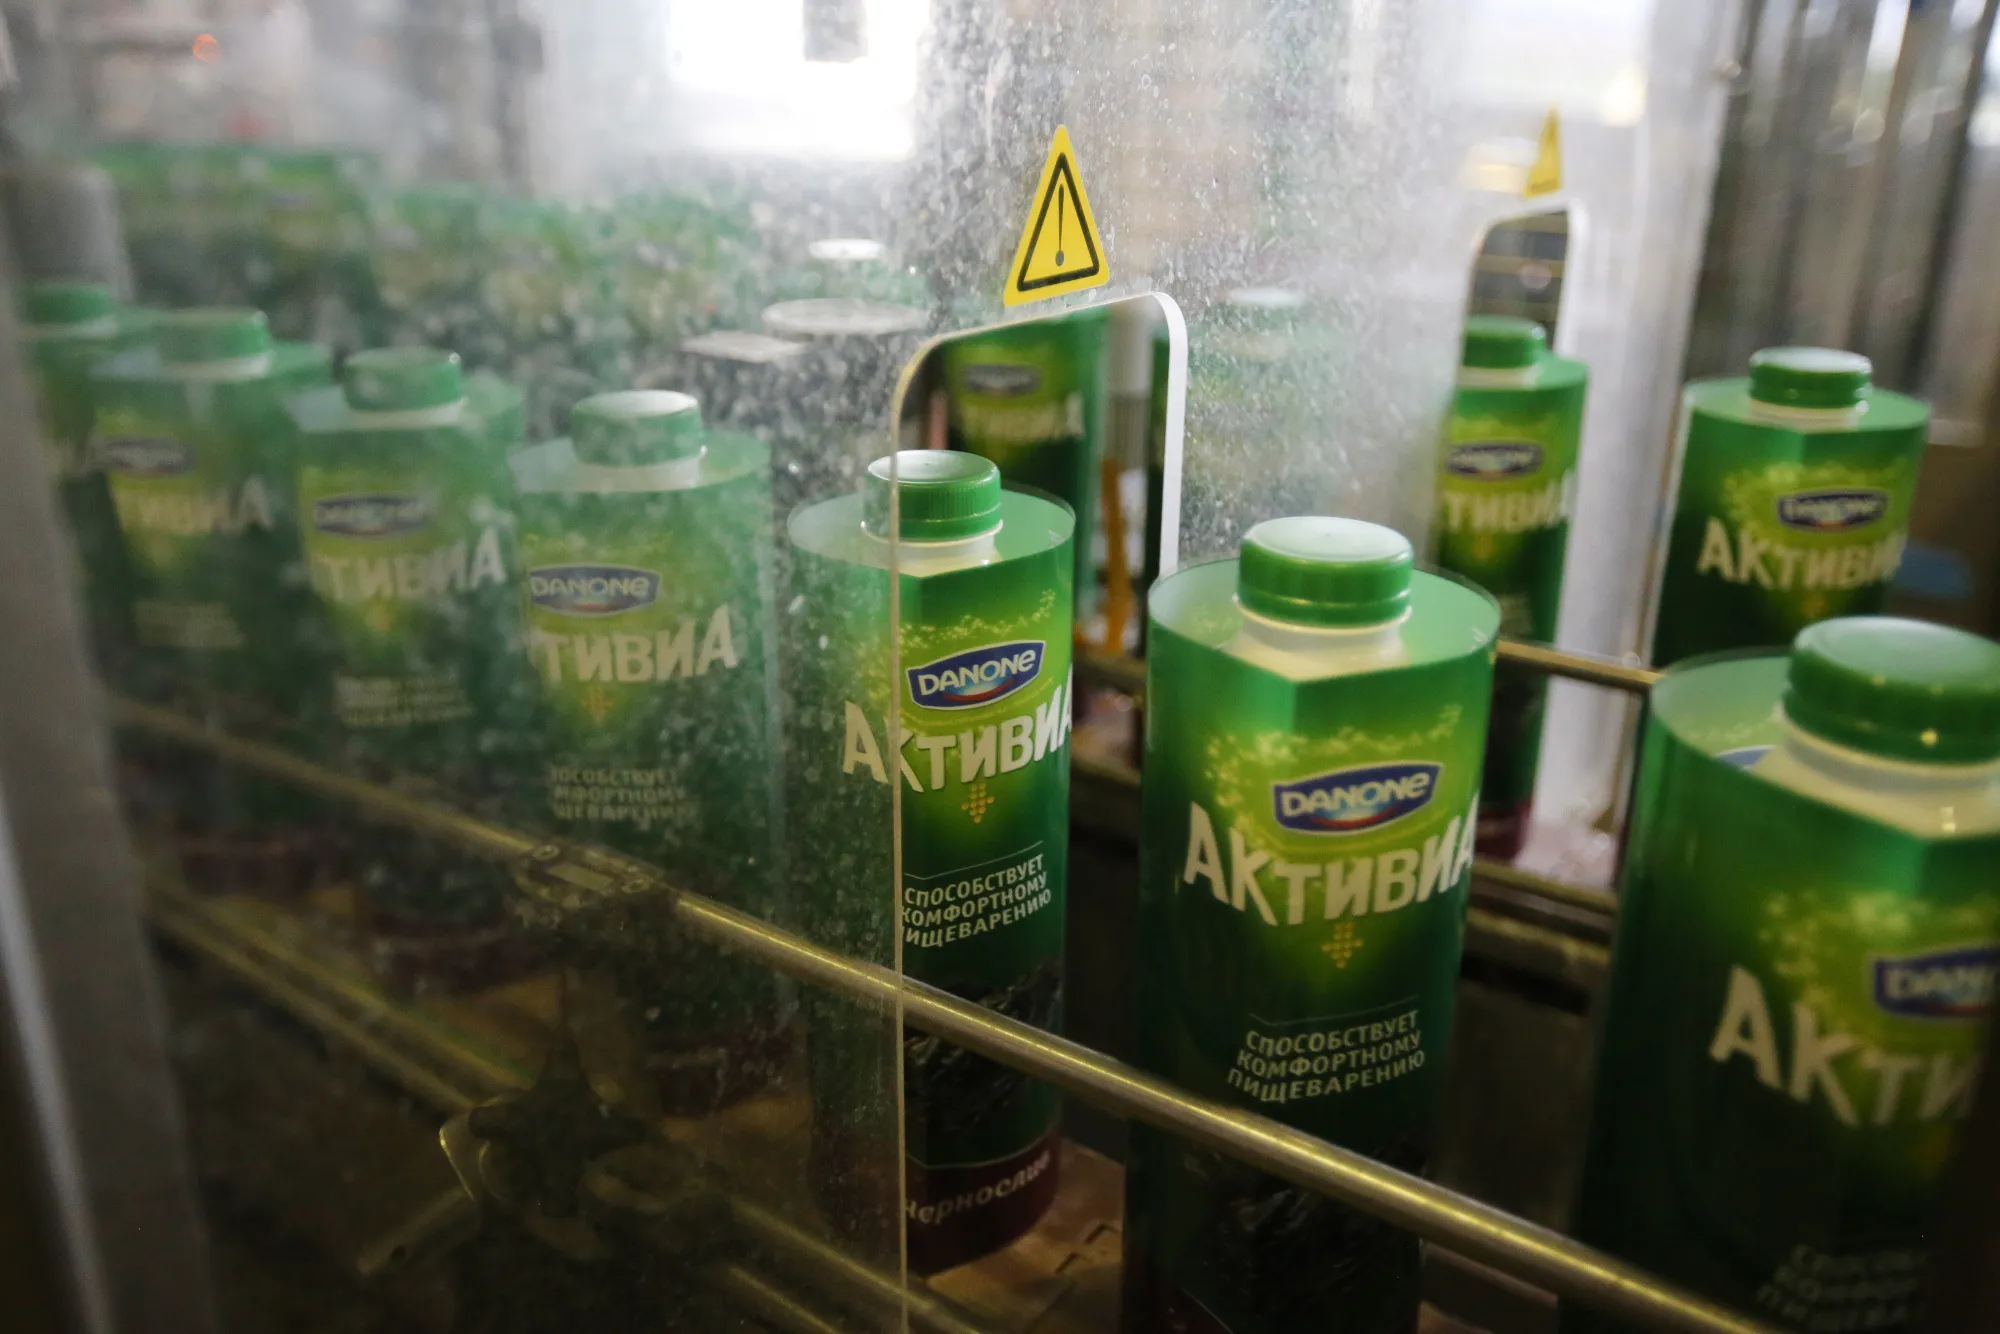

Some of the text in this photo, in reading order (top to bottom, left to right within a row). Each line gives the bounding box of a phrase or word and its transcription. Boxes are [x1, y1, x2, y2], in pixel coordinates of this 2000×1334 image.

[530, 576, 651, 597] DANONE
[917, 649, 1037, 696] DANONE
[1280, 772, 1431, 818] DANONE
[904, 853, 1044, 908] СПОСОБСТВУЕТ
[1183, 792, 1480, 927] АКТИВИА
[902, 871, 1048, 927] КОМФОРТНОМУ
[1237, 1029, 1421, 1080] КОМФОРТНОМУ
[1246, 1010, 1418, 1057] СПОСОБСТВУЕТ
[1227, 1050, 1425, 1104] ПИЩЕВАРЕНИЮ
